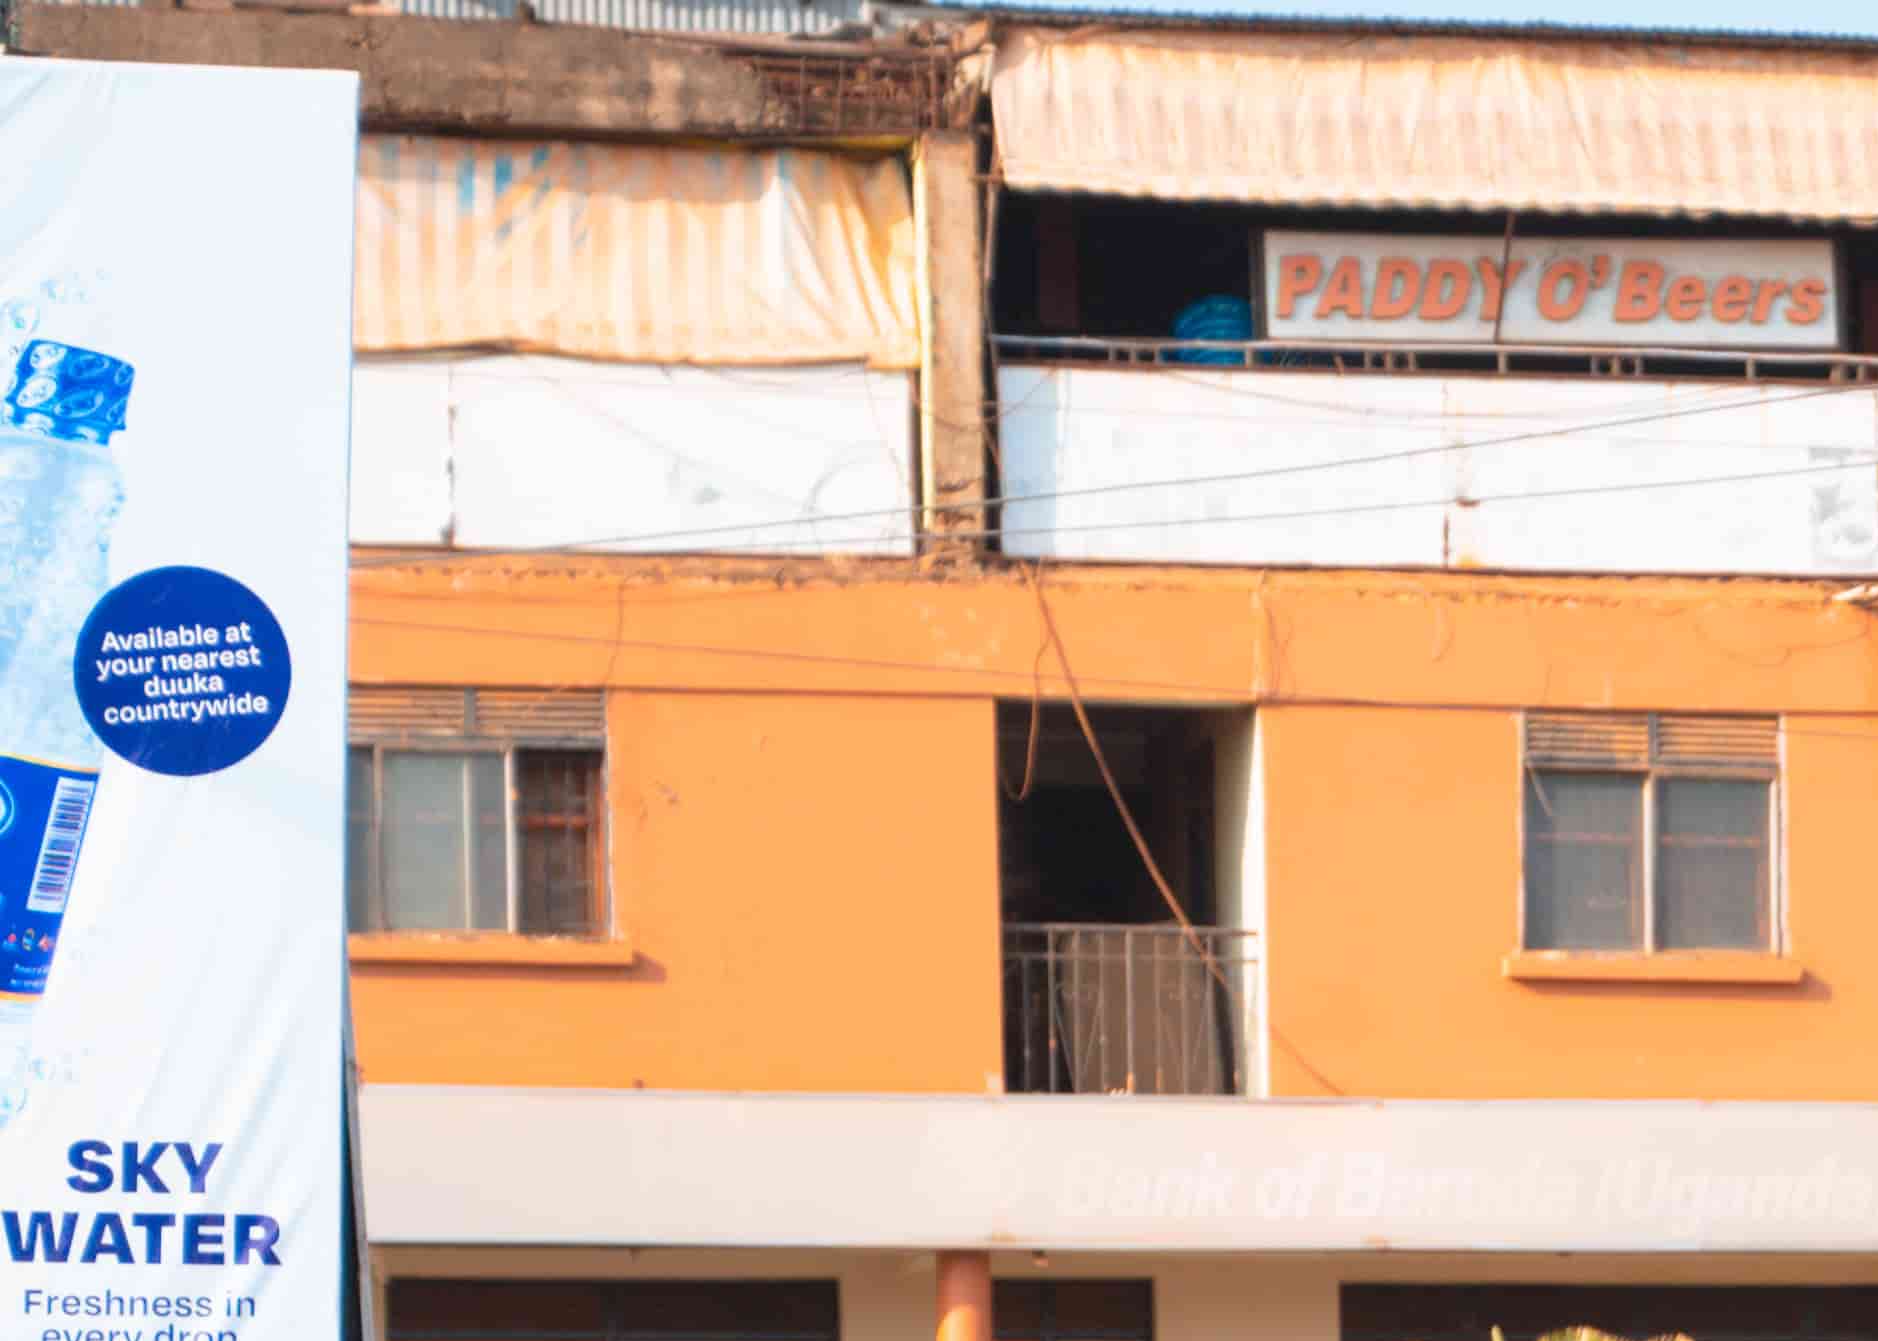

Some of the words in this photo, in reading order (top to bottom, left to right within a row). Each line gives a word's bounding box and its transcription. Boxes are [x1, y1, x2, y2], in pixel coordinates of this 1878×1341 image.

[1276, 254, 1527, 321] PADDY
[1536, 253, 1826, 324] O'Beers
[101, 623, 219, 652] Available
[225, 621, 252, 644] at
[96, 654, 155, 682] your
[161, 645, 262, 672] nearest
[143, 672, 225, 698] duuka
[103, 692, 269, 724] countrywide
[66, 1139, 223, 1194] SKY
[1, 1210, 282, 1265] WATER
[24, 1288, 213, 1318] Freshness
[225, 1289, 256, 1318] in
